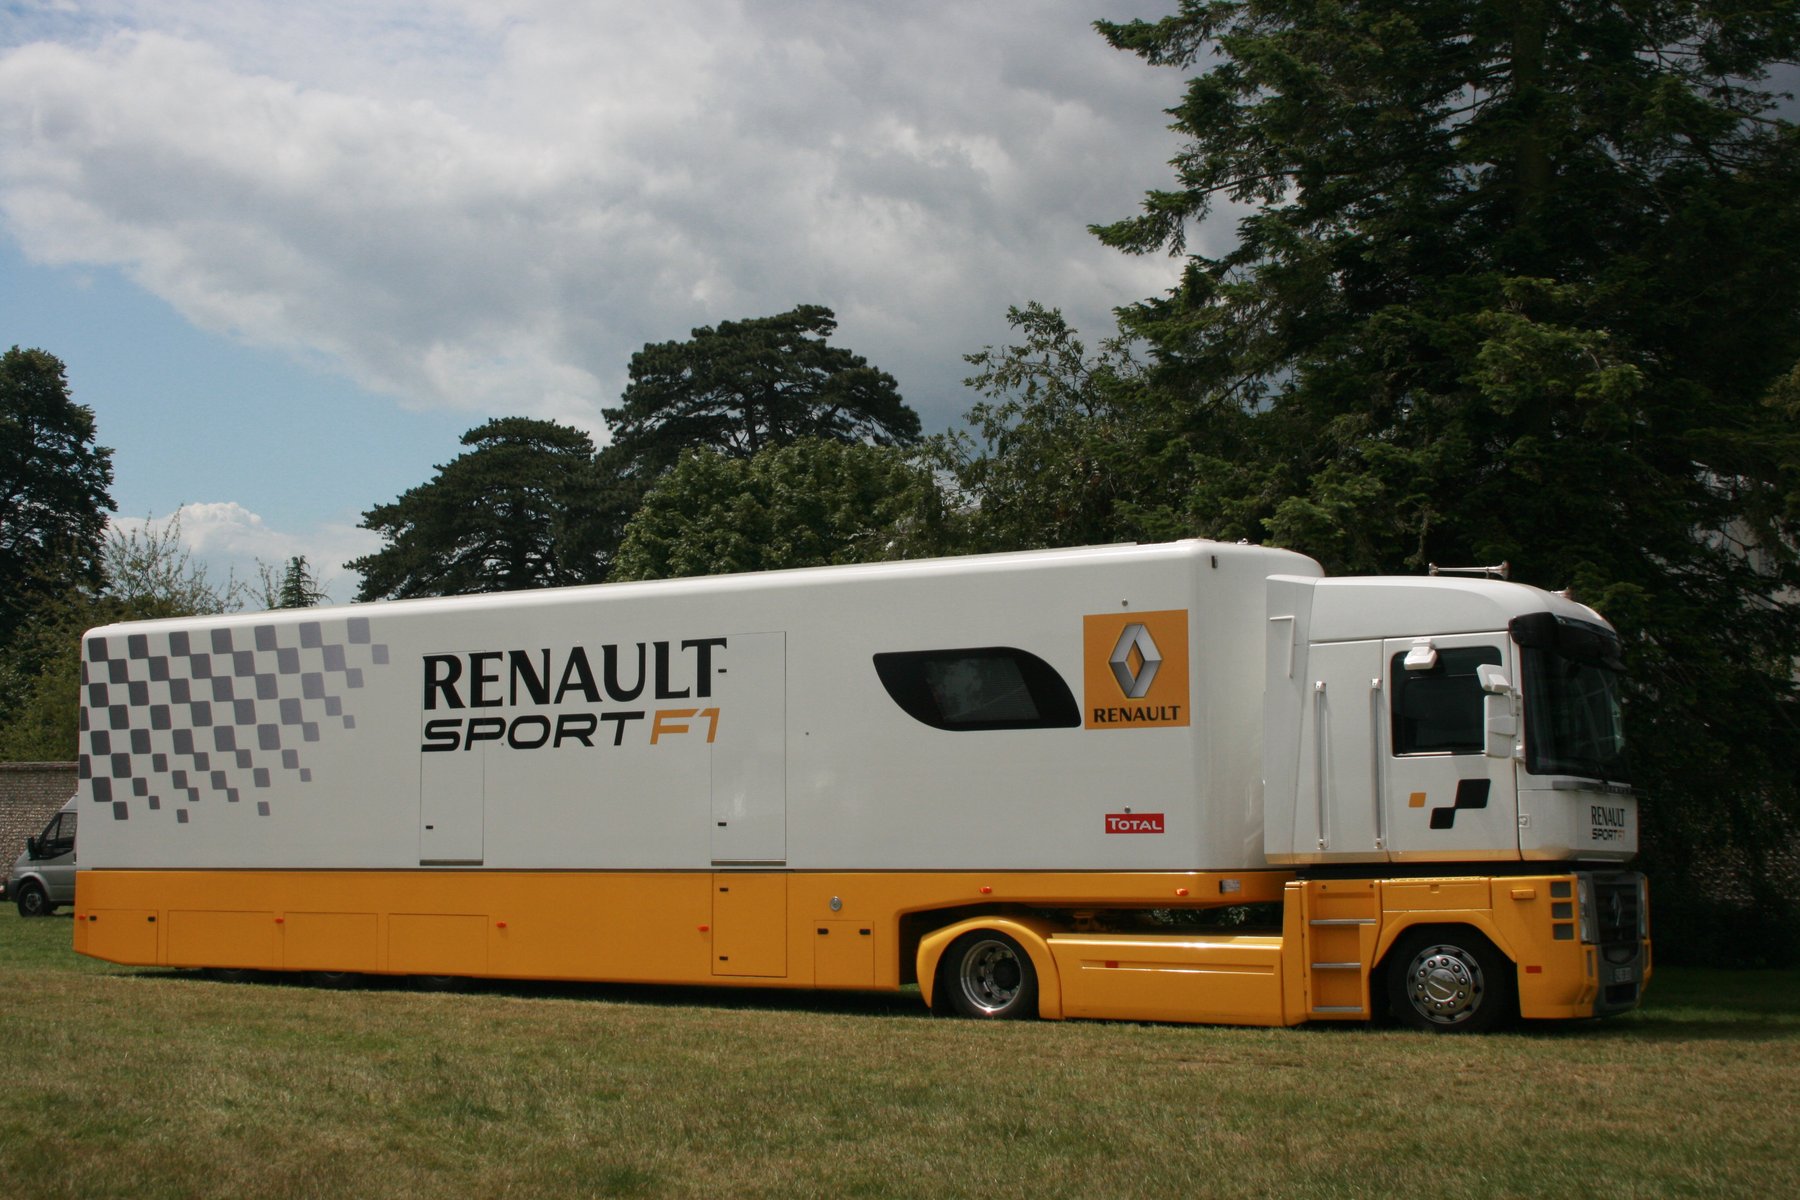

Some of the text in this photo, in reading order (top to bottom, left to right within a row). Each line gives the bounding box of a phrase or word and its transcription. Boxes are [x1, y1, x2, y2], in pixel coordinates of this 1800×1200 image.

[422, 637, 727, 710] RENAULT
[1093, 705, 1181, 723] RENAULT
[1107, 817, 1162, 831] TOTAL
[1591, 805, 1625, 827] RENAULT
